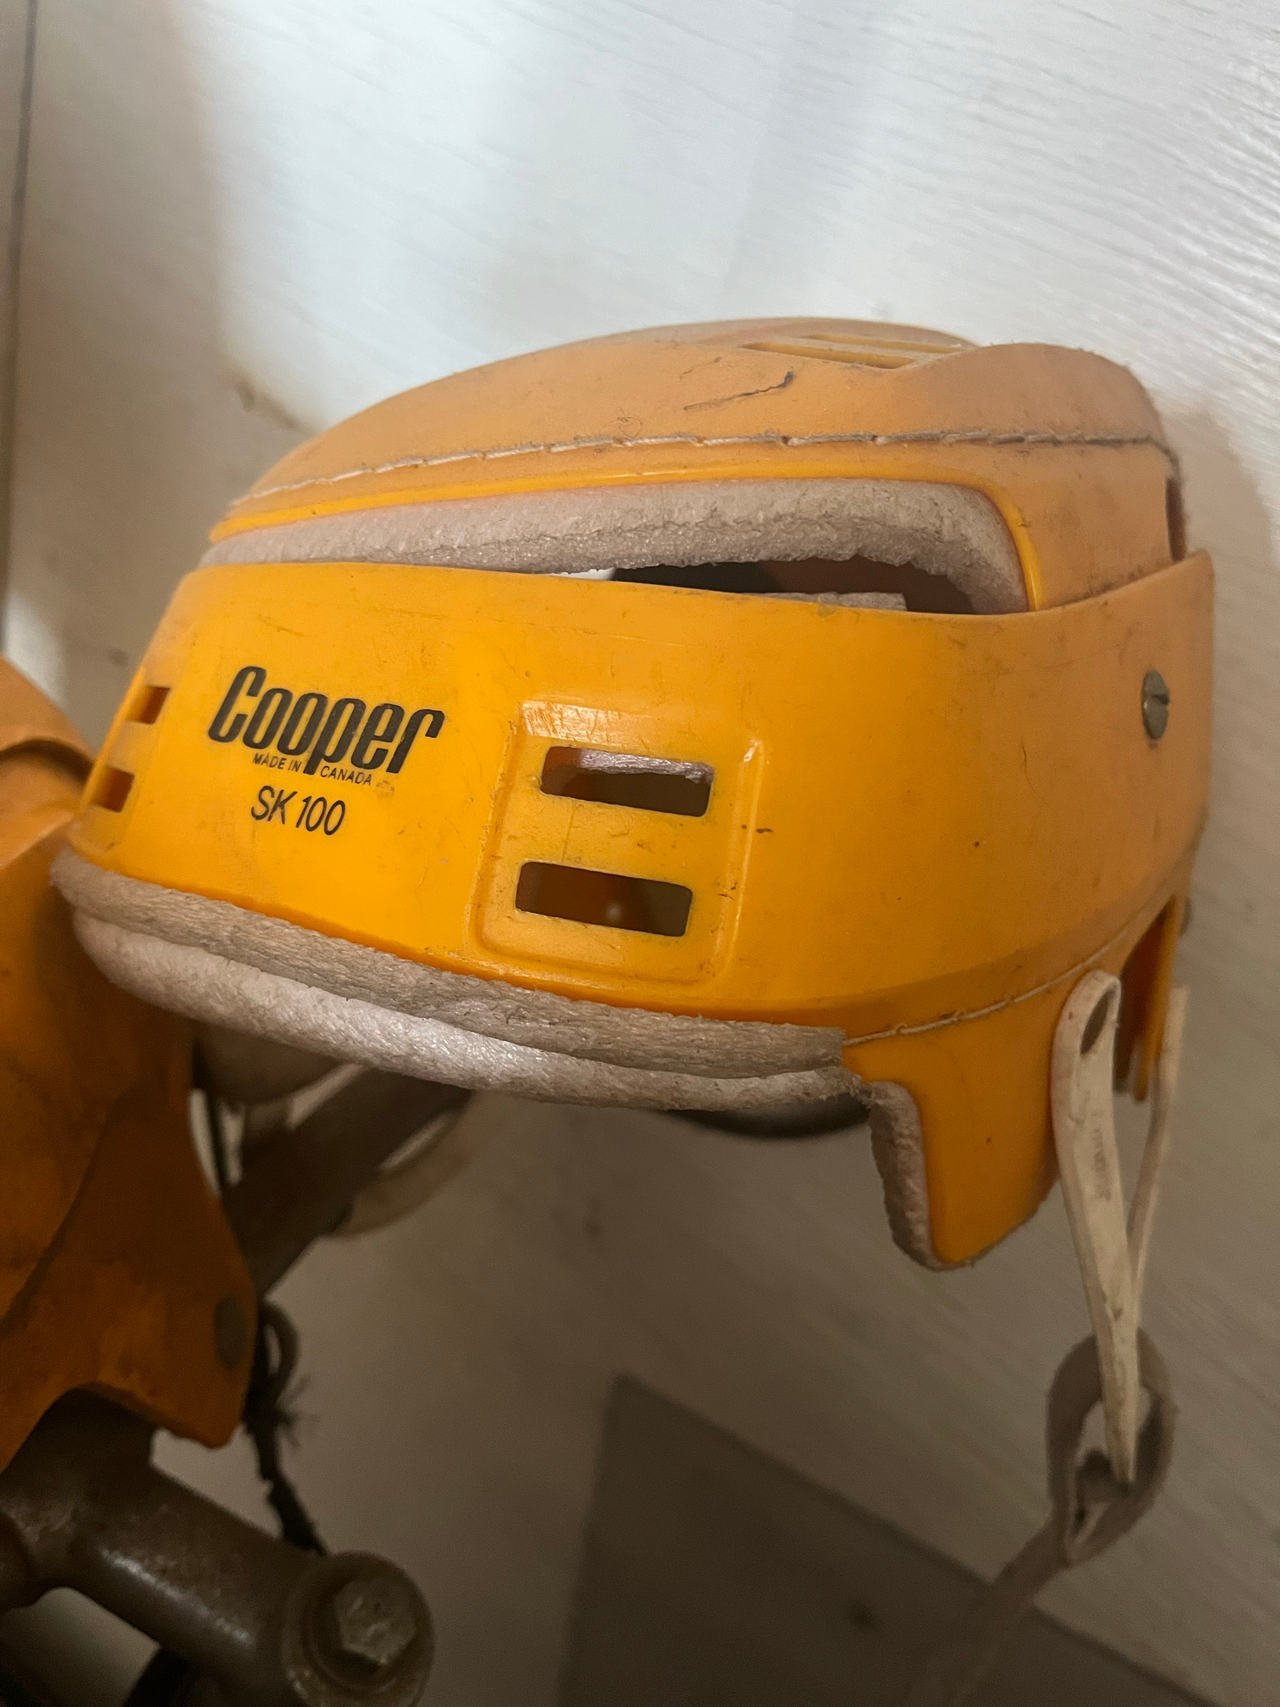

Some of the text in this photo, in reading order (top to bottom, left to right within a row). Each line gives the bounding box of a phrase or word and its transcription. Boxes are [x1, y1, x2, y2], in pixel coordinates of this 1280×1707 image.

[208, 666, 445, 775] Cooper
[253, 753, 372, 786] MADE IN CANADA
[251, 785, 346, 836] SK 100
